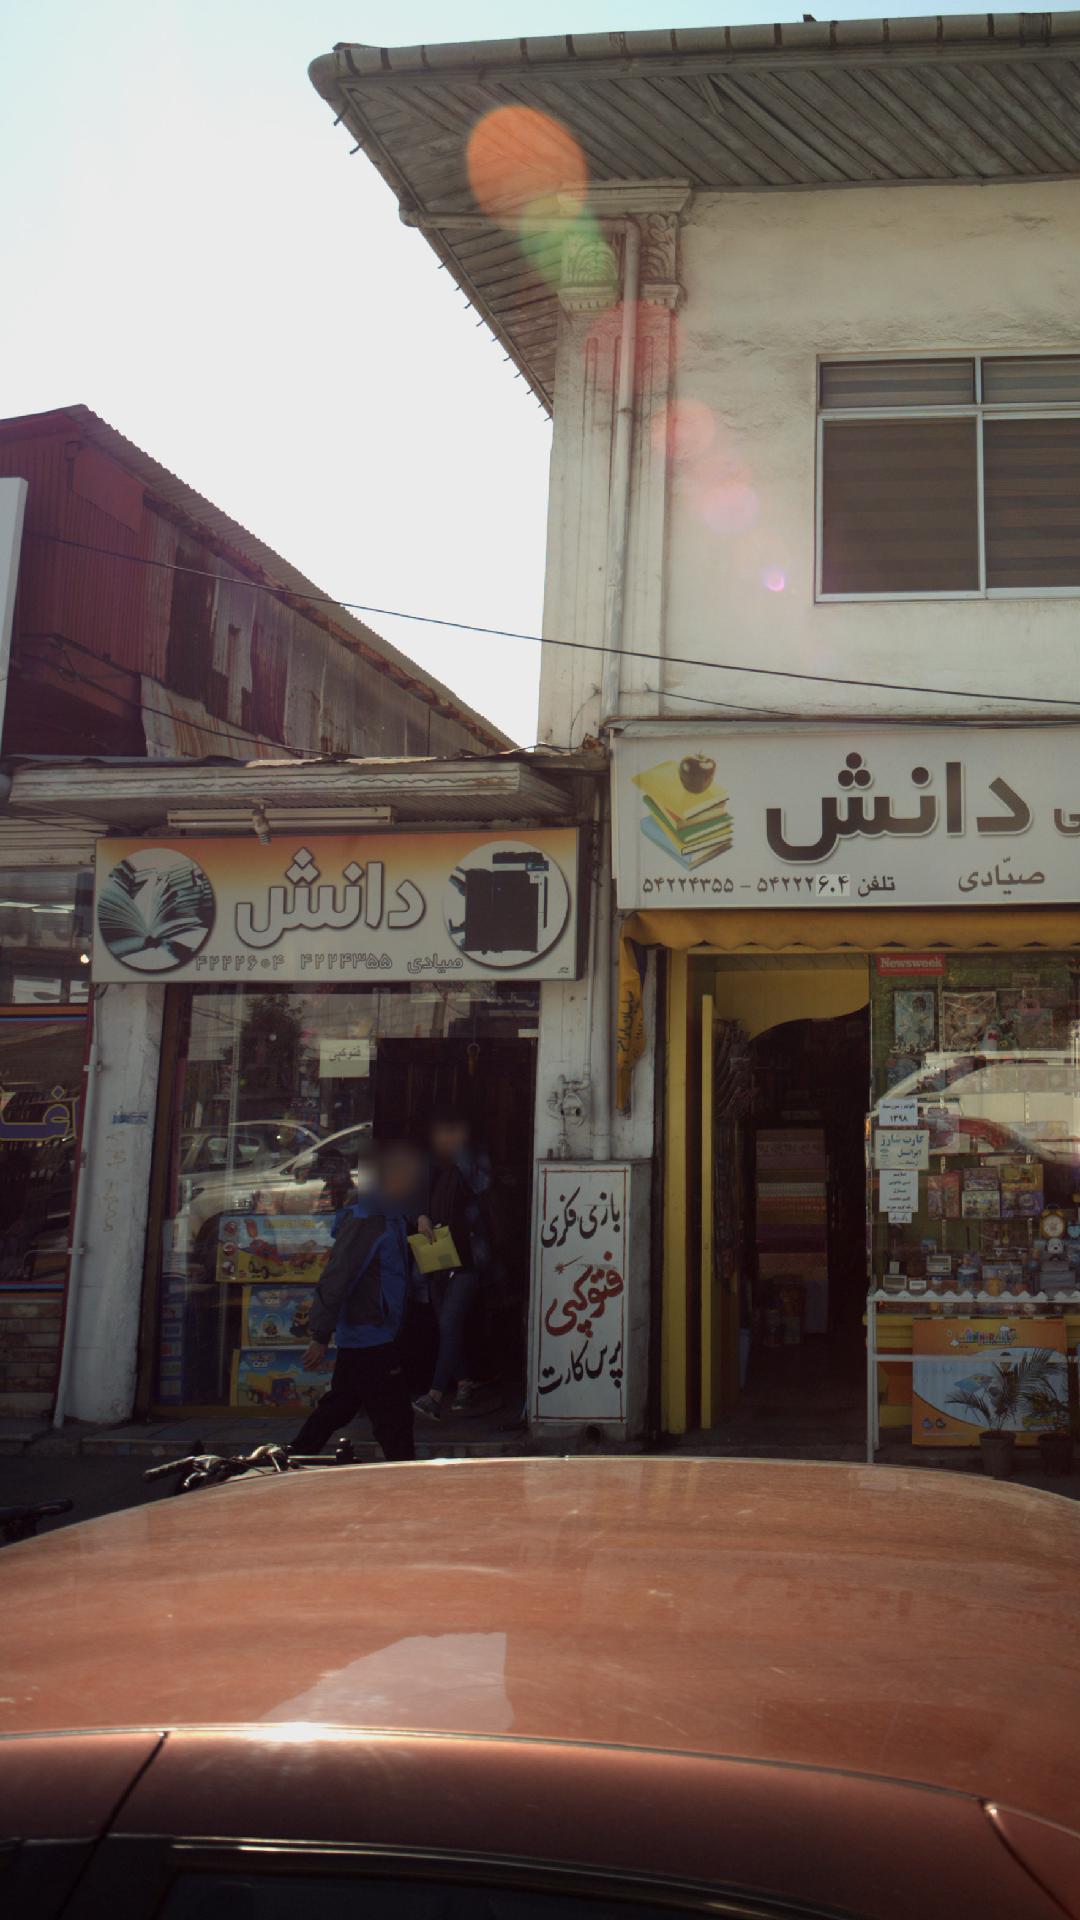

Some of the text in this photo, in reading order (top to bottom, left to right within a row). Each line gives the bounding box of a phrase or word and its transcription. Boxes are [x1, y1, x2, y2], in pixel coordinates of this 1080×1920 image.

[765, 752, 1032, 863] دانش
[235, 847, 427, 948] دانش
[857, 875, 896, 897] تلفن
[407, 953, 464, 974] صیادی
[880, 957, 943, 968] Newsweek
[541, 1187, 621, 1248] بازی فکری
[545, 1251, 624, 1338] فتوکپی
[538, 1340, 623, 1394] پرس کارت
